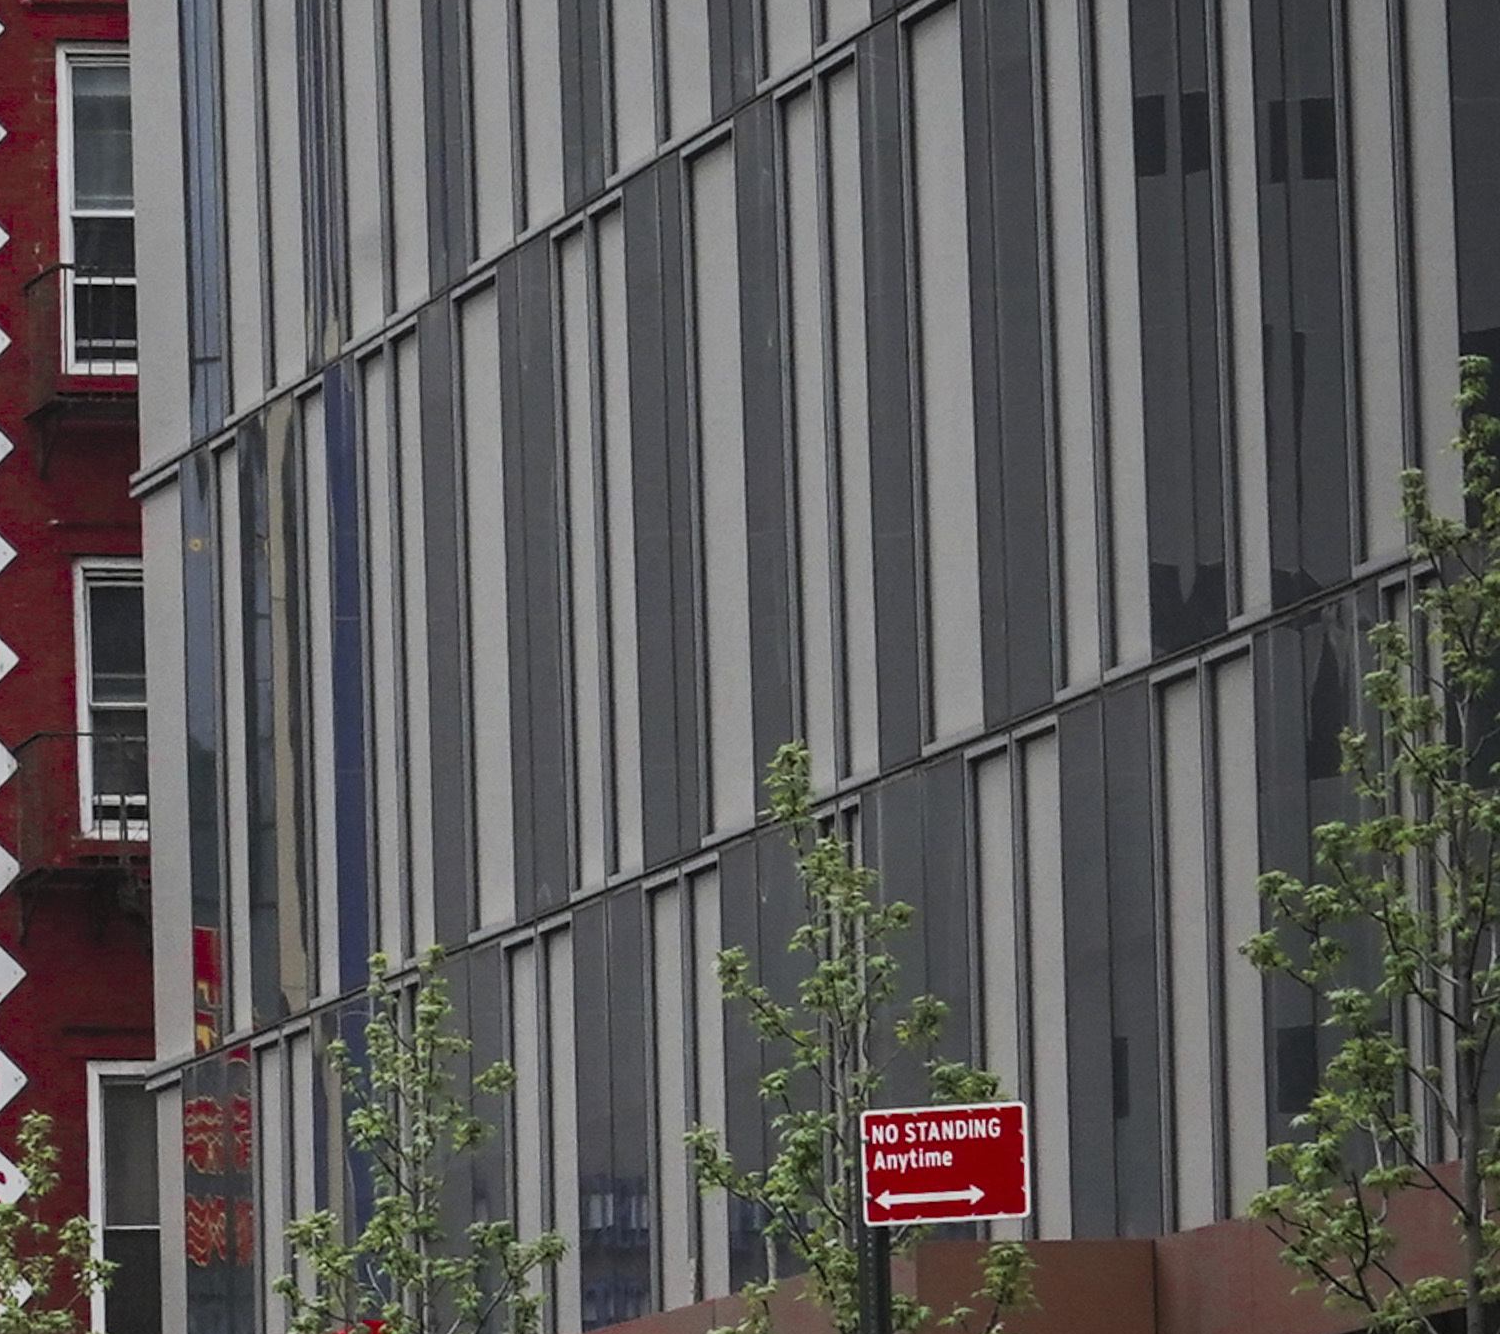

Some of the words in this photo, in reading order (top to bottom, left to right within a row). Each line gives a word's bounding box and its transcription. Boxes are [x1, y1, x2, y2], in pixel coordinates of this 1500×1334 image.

[871, 1121, 900, 1146] NO
[904, 1116, 1002, 1143] STANDING
[872, 1147, 954, 1173] Anytime
